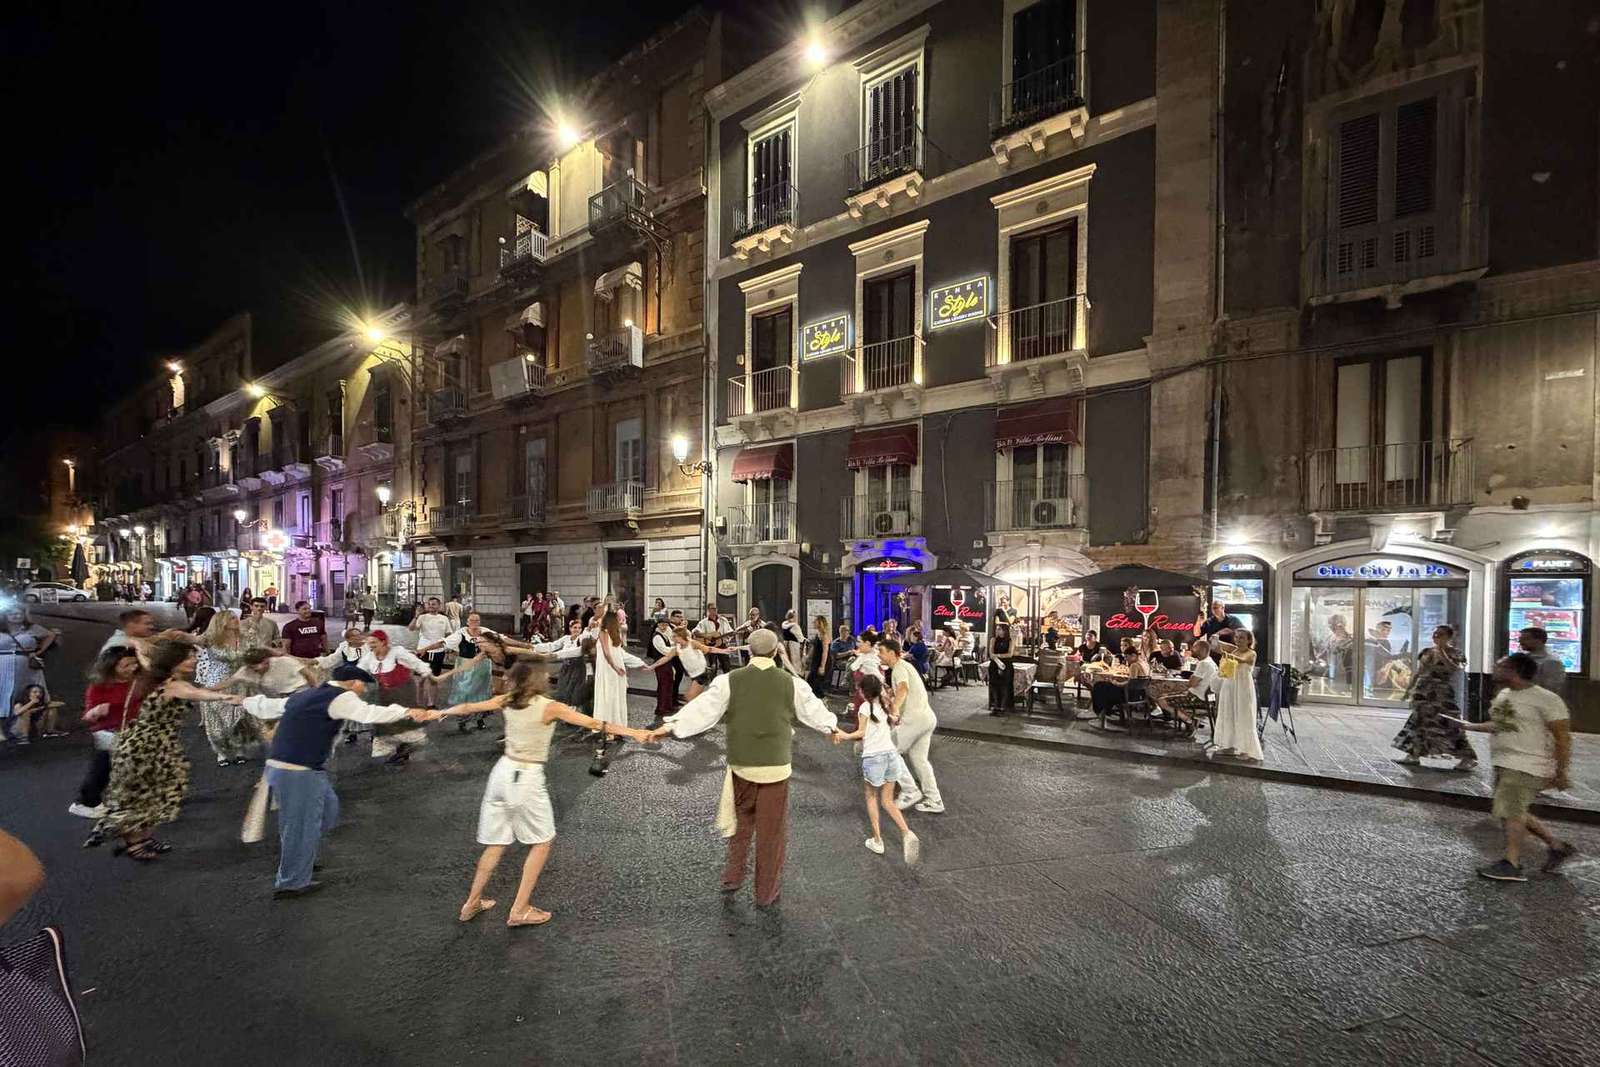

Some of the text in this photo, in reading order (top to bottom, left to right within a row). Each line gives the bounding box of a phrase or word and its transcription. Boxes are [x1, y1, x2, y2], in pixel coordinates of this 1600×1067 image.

[939, 291, 978, 317] Style
[810, 328, 841, 351] Style
[298, 626, 318, 635] VANS
[1105, 613, 1142, 629] Etna
